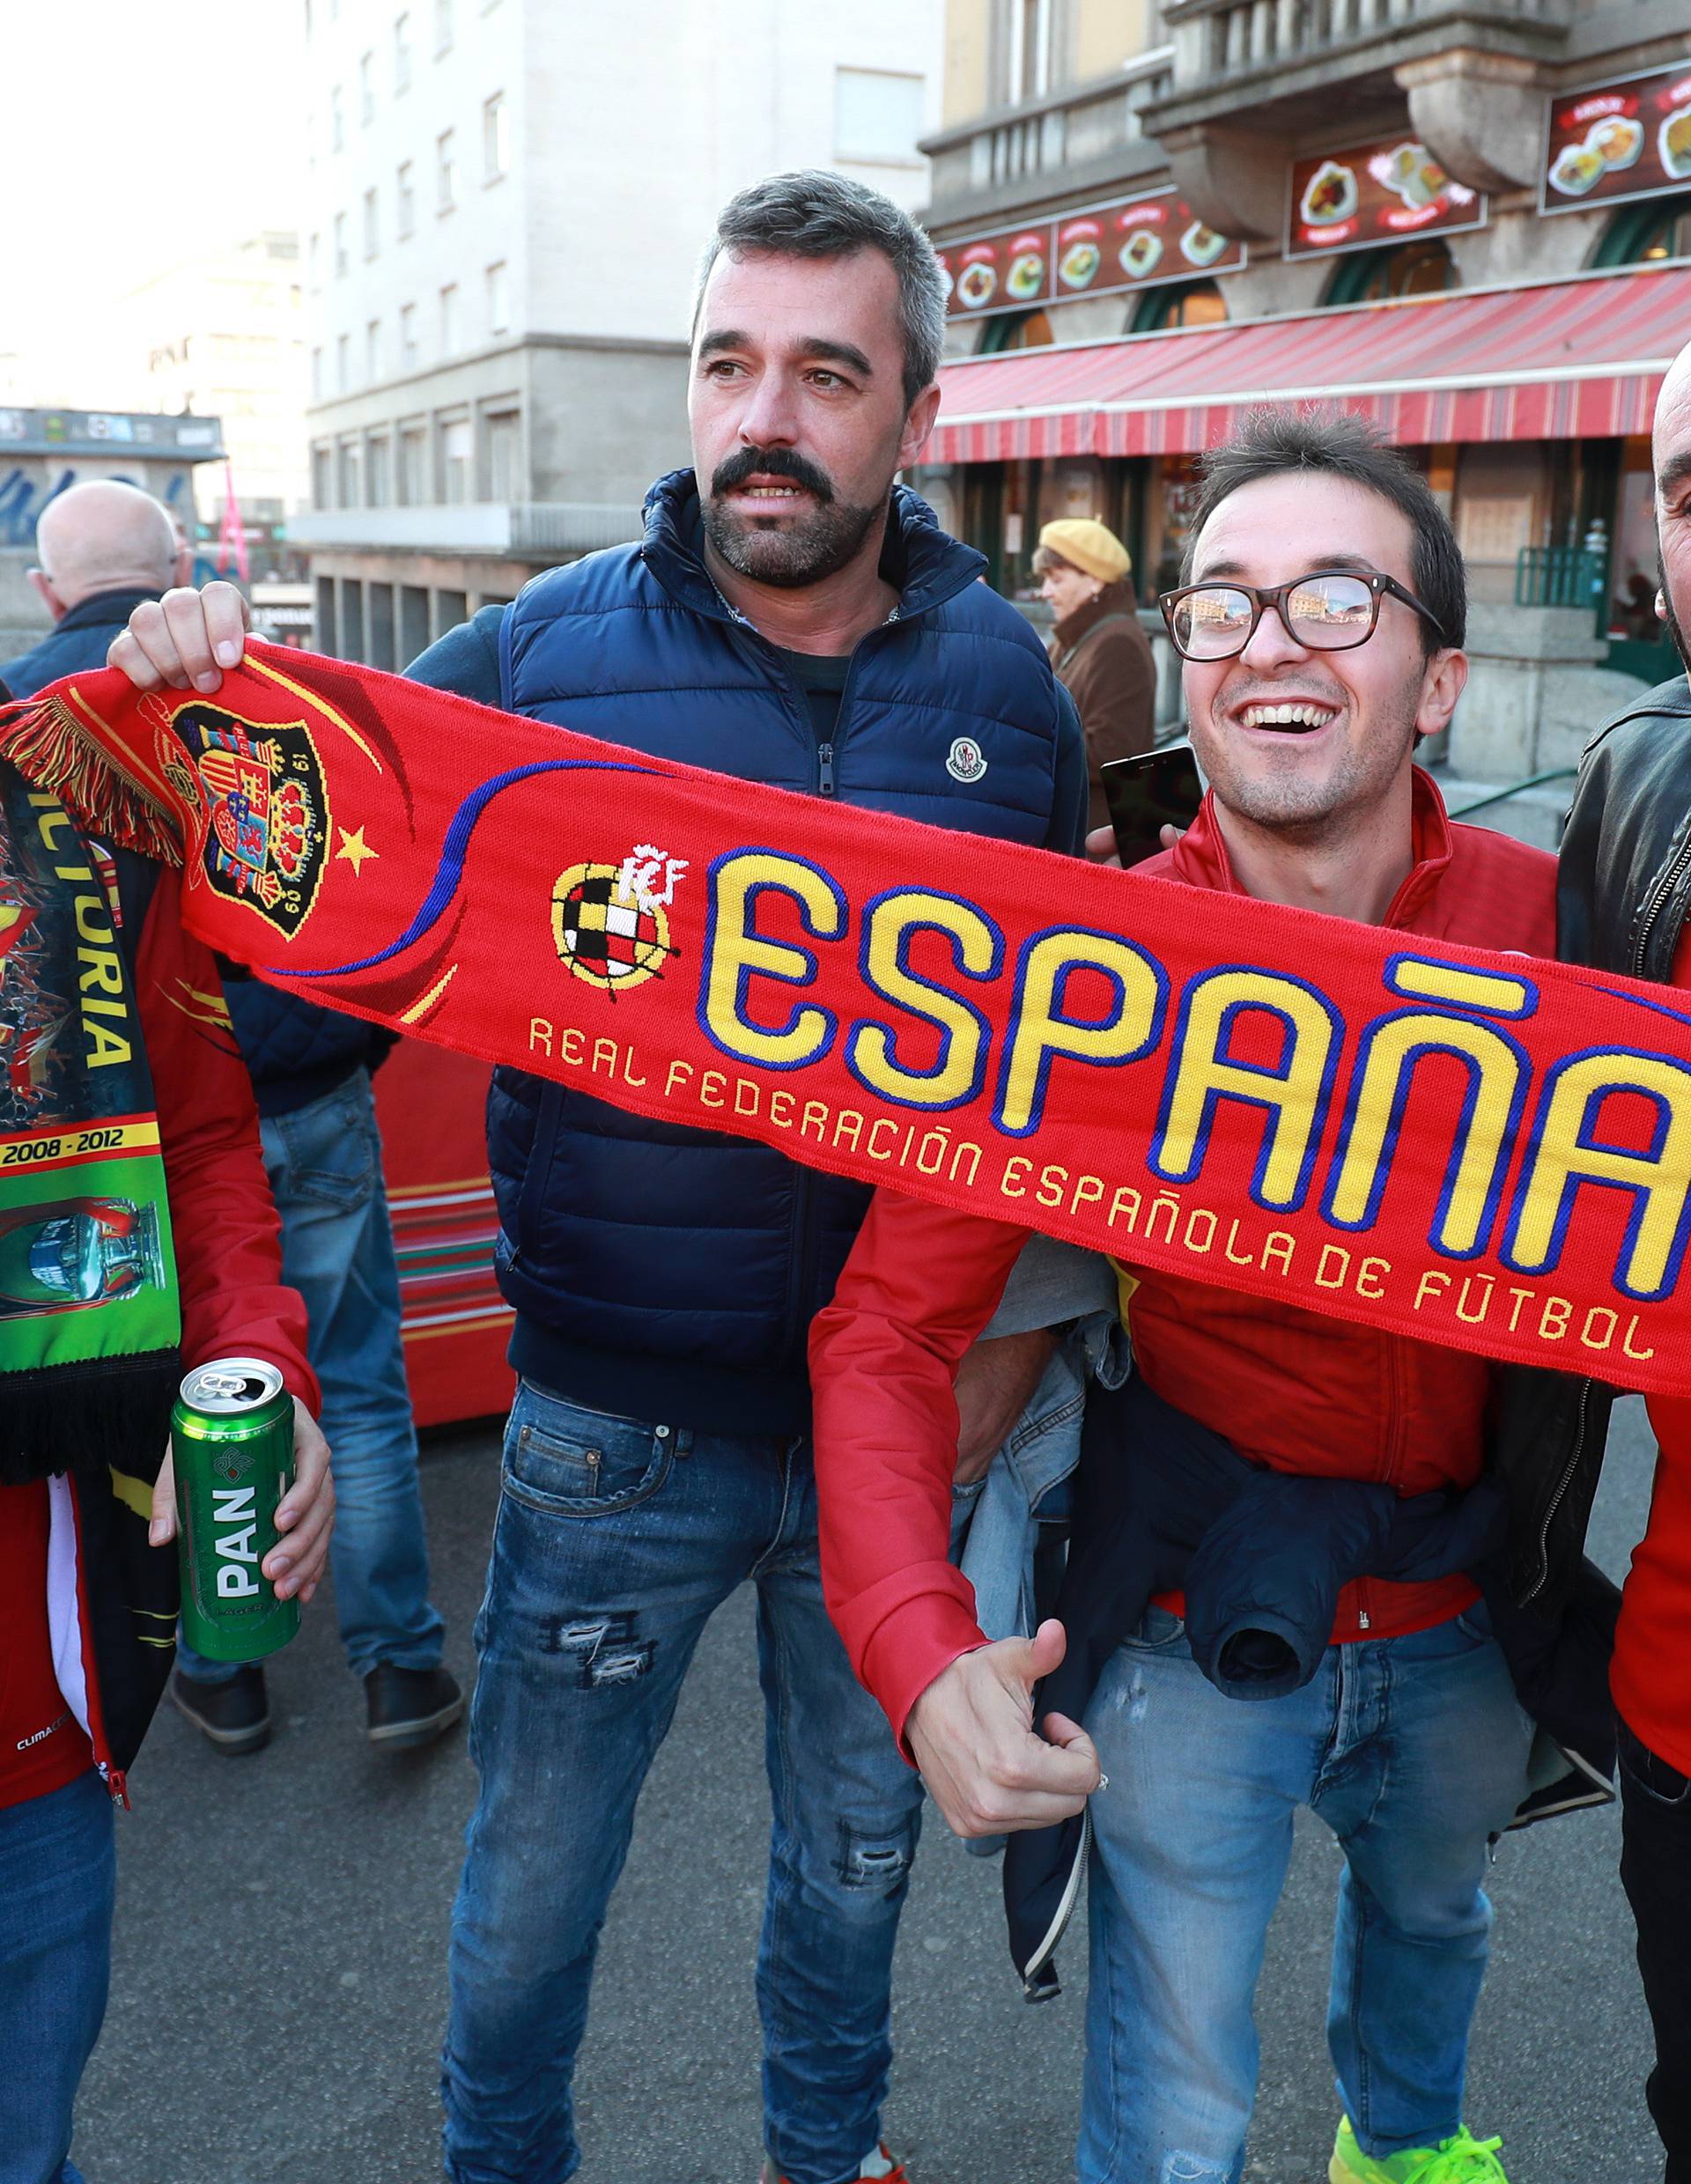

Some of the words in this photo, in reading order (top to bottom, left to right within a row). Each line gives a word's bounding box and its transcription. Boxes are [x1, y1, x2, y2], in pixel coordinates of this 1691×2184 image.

[292, 753, 309, 771] 19
[284, 889, 301, 913] 09
[3, 1139, 61, 1164] 2008
[77, 1129, 123, 1152] 2012
[529, 1016, 648, 1088] REAL
[664, 1059, 983, 1186] FEDERACIÓN
[1001, 1155, 1296, 1276] ESPAÑOLA
[1315, 1244, 1393, 1299] DE
[1414, 1270, 1655, 1361] FÚTBOL
[211, 1486, 260, 1598] PAN
[217, 1604, 263, 1616] LAGER
